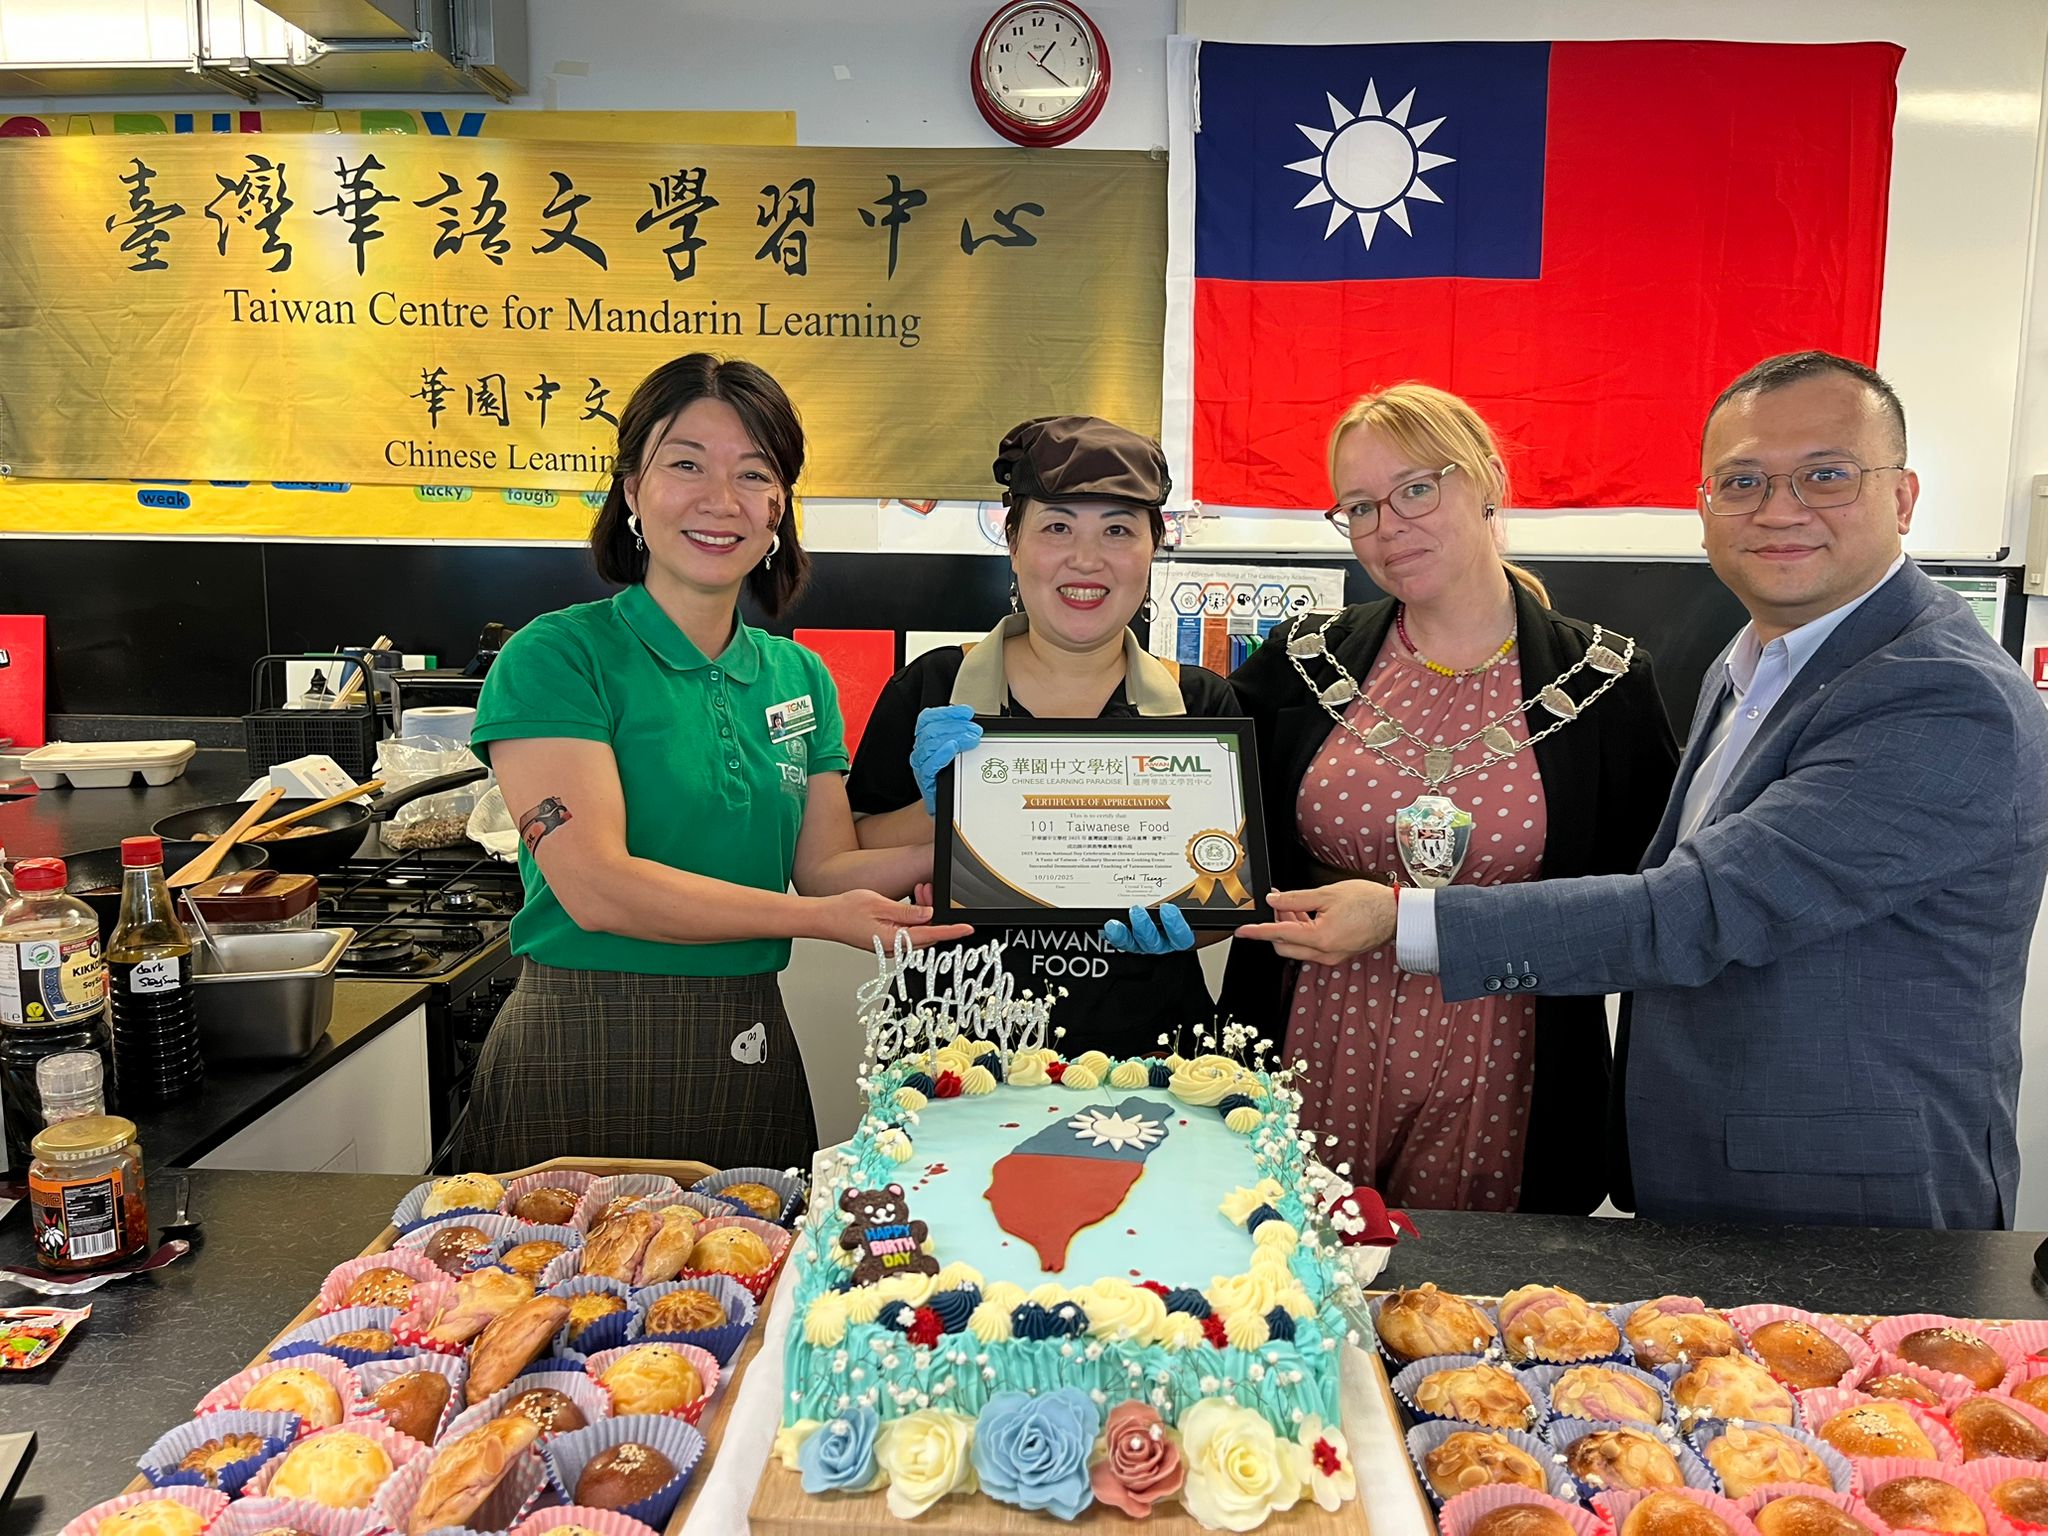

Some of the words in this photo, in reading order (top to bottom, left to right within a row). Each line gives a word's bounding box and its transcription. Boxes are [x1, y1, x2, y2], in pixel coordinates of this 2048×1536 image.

[1032, 17, 1044, 27] 12
[1055, 23, 1060, 32] 1
[1012, 26, 1023, 36] 11
[1000, 43, 1013, 53] 10
[1070, 37, 1077, 47] 2
[995, 65, 1002, 74] 9
[1078, 57, 1085, 66] 3
[1019, 98, 1024, 107] 7
[106, 154, 1045, 281] 臺灣華語文學習中心
[224, 288, 356, 325] Taiwan
[369, 291, 488, 328] Centre
[502, 294, 553, 330] for
[567, 298, 742, 336] Mandarin
[756, 302, 921, 347] Learning
[410, 367, 619, 430] 華園中文
[385, 440, 497, 469] Chinese
[508, 444, 613, 473] Learnin
[142, 491, 185, 507] weak
[507, 488, 554, 504] tough
[1012, 757, 1124, 775] 華園中文學校
[1131, 755, 1211, 772] TCML
[1030, 798, 1086, 807] CERTIFICATE
[1088, 798, 1101, 806] OF
[1102, 798, 1165, 807] APPRECIATION
[1031, 821, 1054, 832] 101
[1066, 821, 1130, 832] Taiwanese
[1139, 821, 1169, 832] Food
[137, 963, 164, 974] dark
[857, 928, 1007, 1002] Happy
[1032, 955, 1109, 978] FOOD
[858, 972, 1049, 1060] Birthday
[865, 1224, 911, 1241] HAPPY
[870, 1237, 916, 1256] BIRTH
[882, 1252, 911, 1268] DAY
